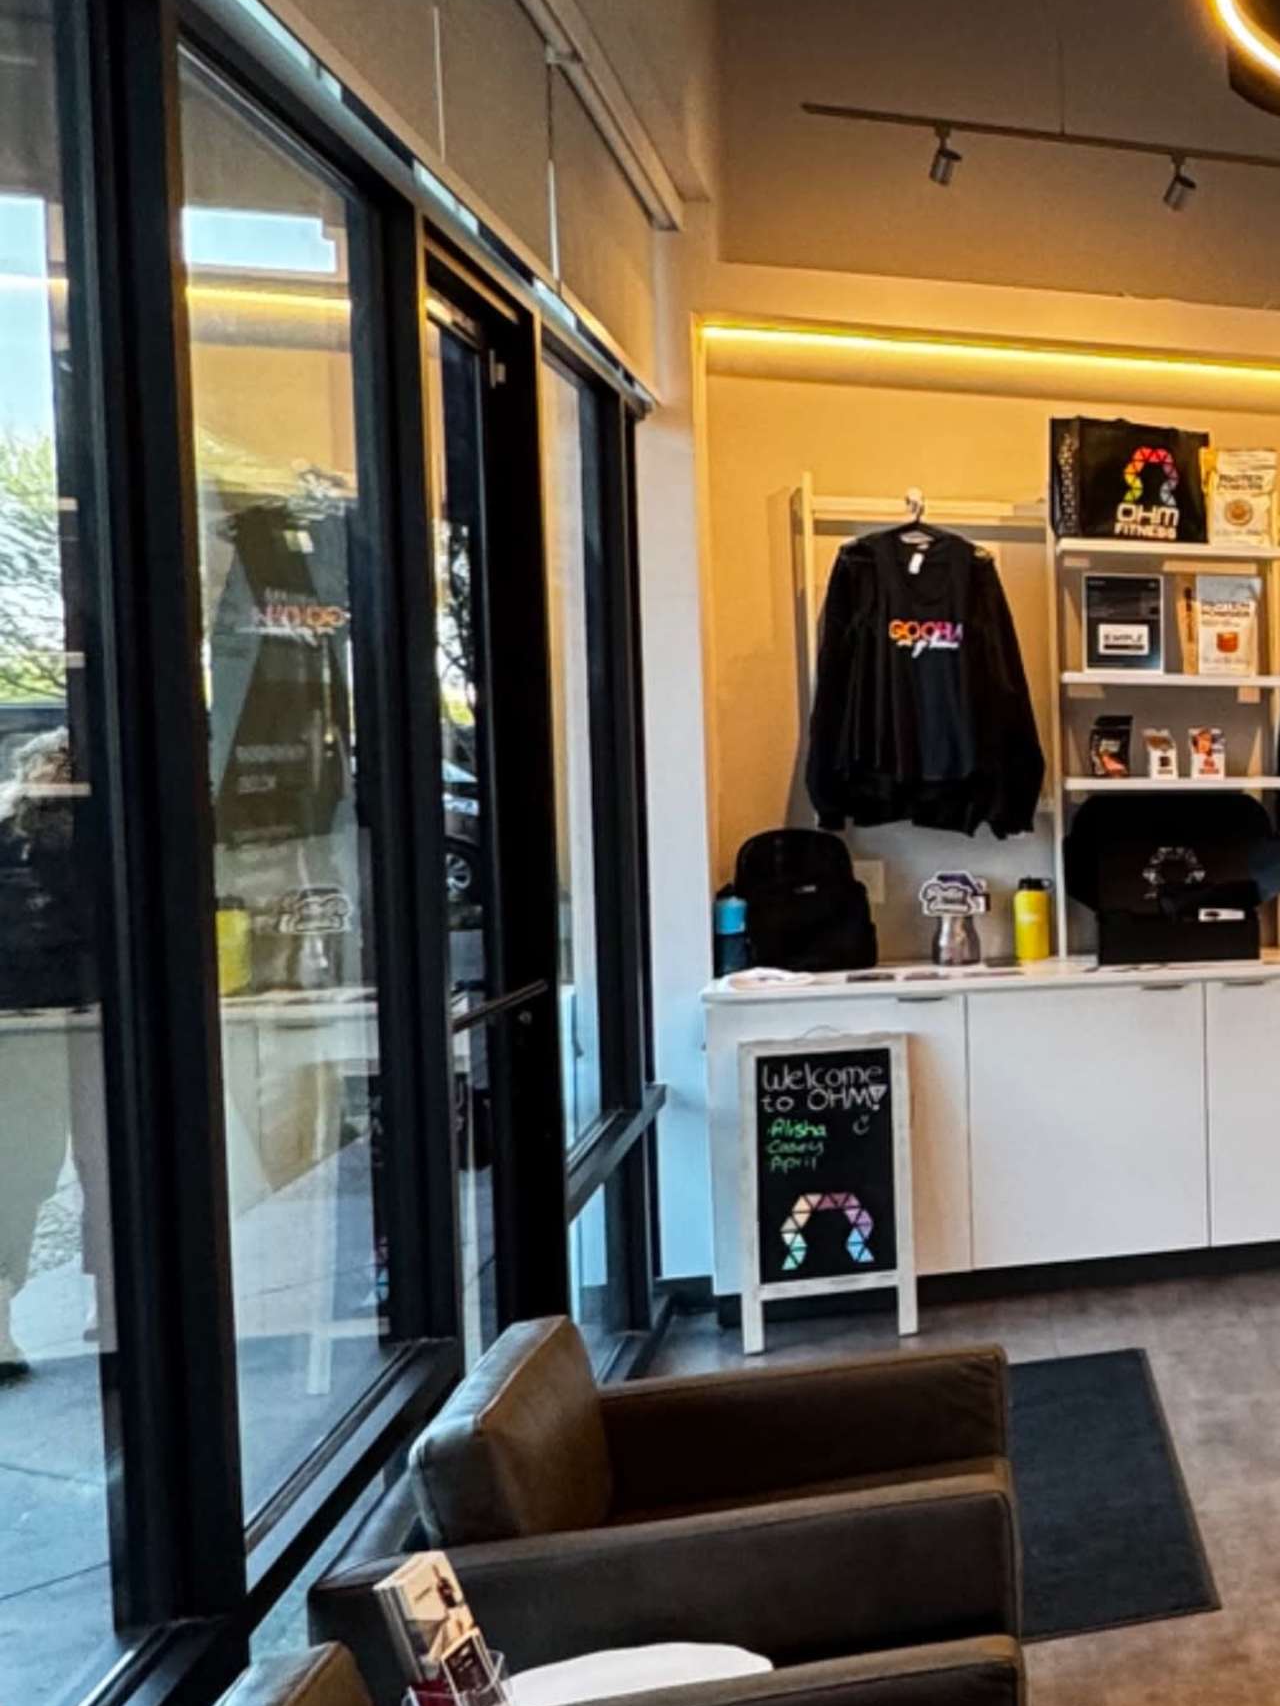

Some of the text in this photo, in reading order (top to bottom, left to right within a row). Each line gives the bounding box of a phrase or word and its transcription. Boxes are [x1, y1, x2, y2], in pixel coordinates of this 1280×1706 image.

[1115, 502, 1180, 527] OHM
[1113, 521, 1178, 540] FITNESS
[761, 1062, 884, 1093] Welcome
[761, 1094, 795, 1113] to
